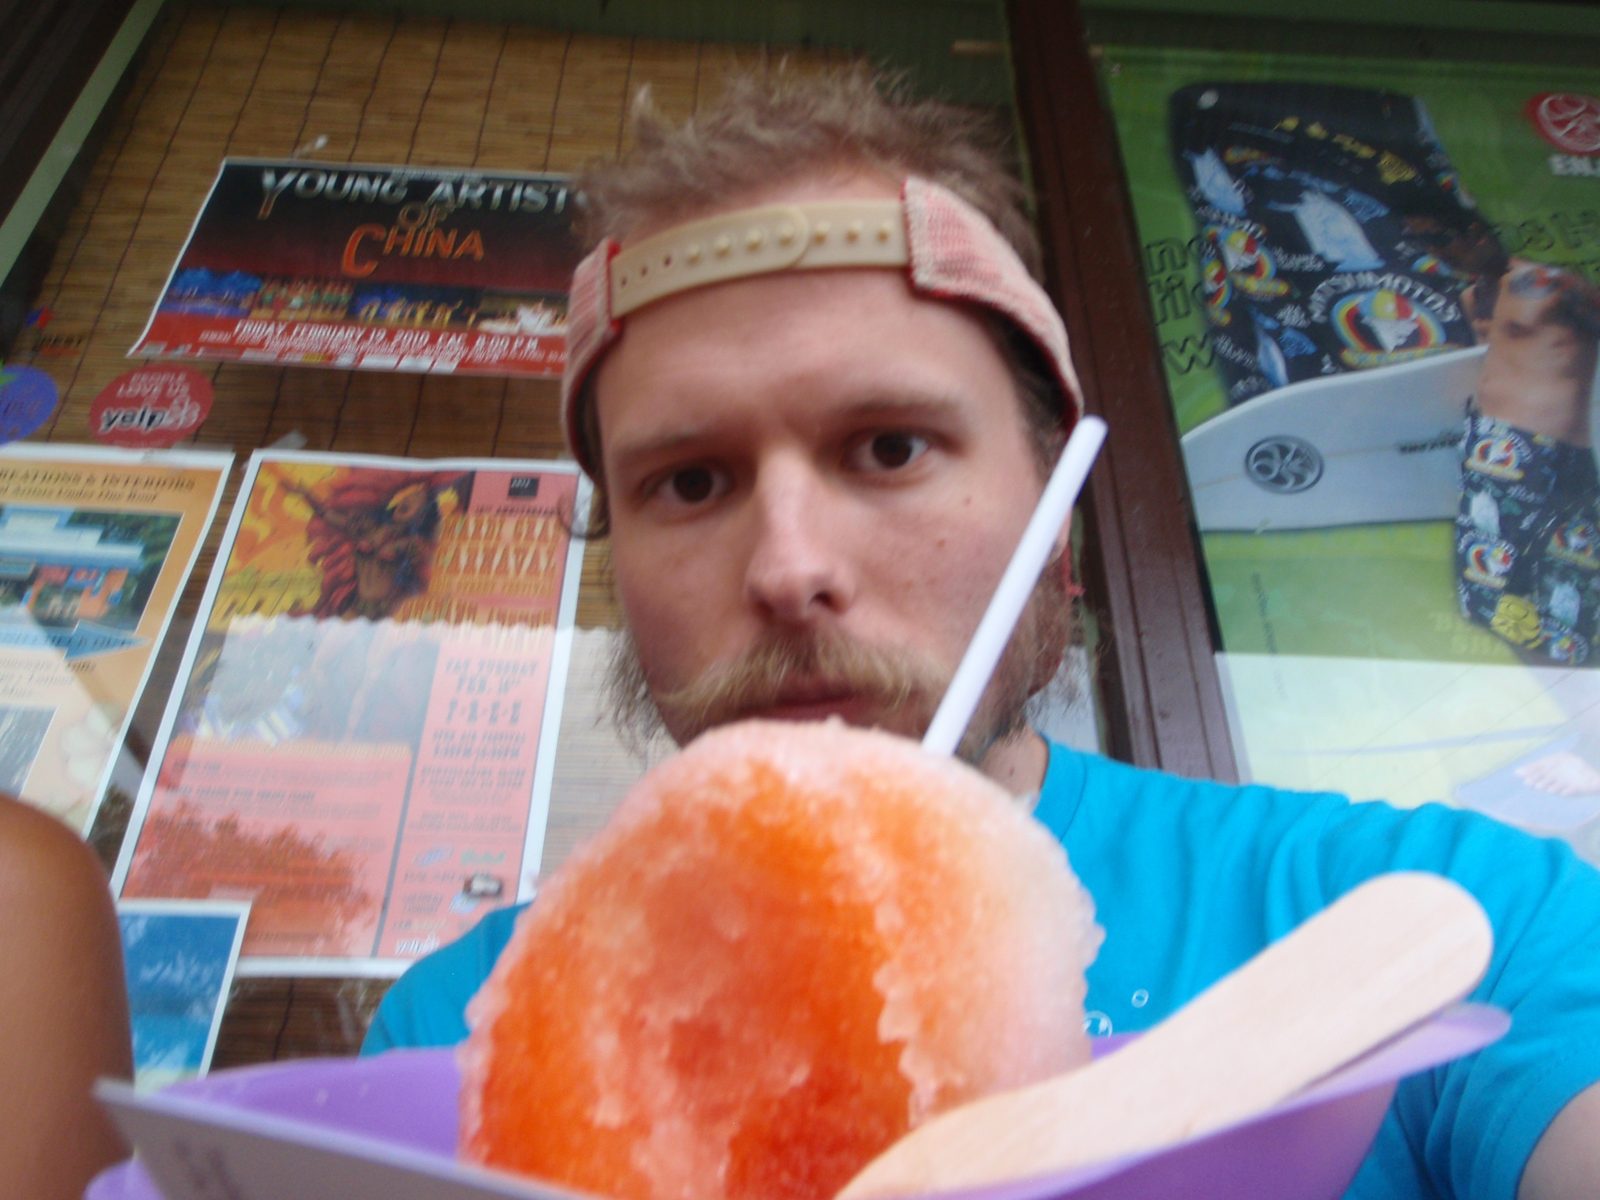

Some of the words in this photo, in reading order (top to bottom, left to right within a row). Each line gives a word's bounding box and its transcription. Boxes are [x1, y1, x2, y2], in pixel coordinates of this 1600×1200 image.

[257, 168, 408, 220] YOUNG
[400, 203, 448, 232] OF
[341, 223, 484, 277] CHINA
[117, 384, 164, 398] LOVE
[167, 383, 191, 399] US
[99, 404, 168, 433] yelp
